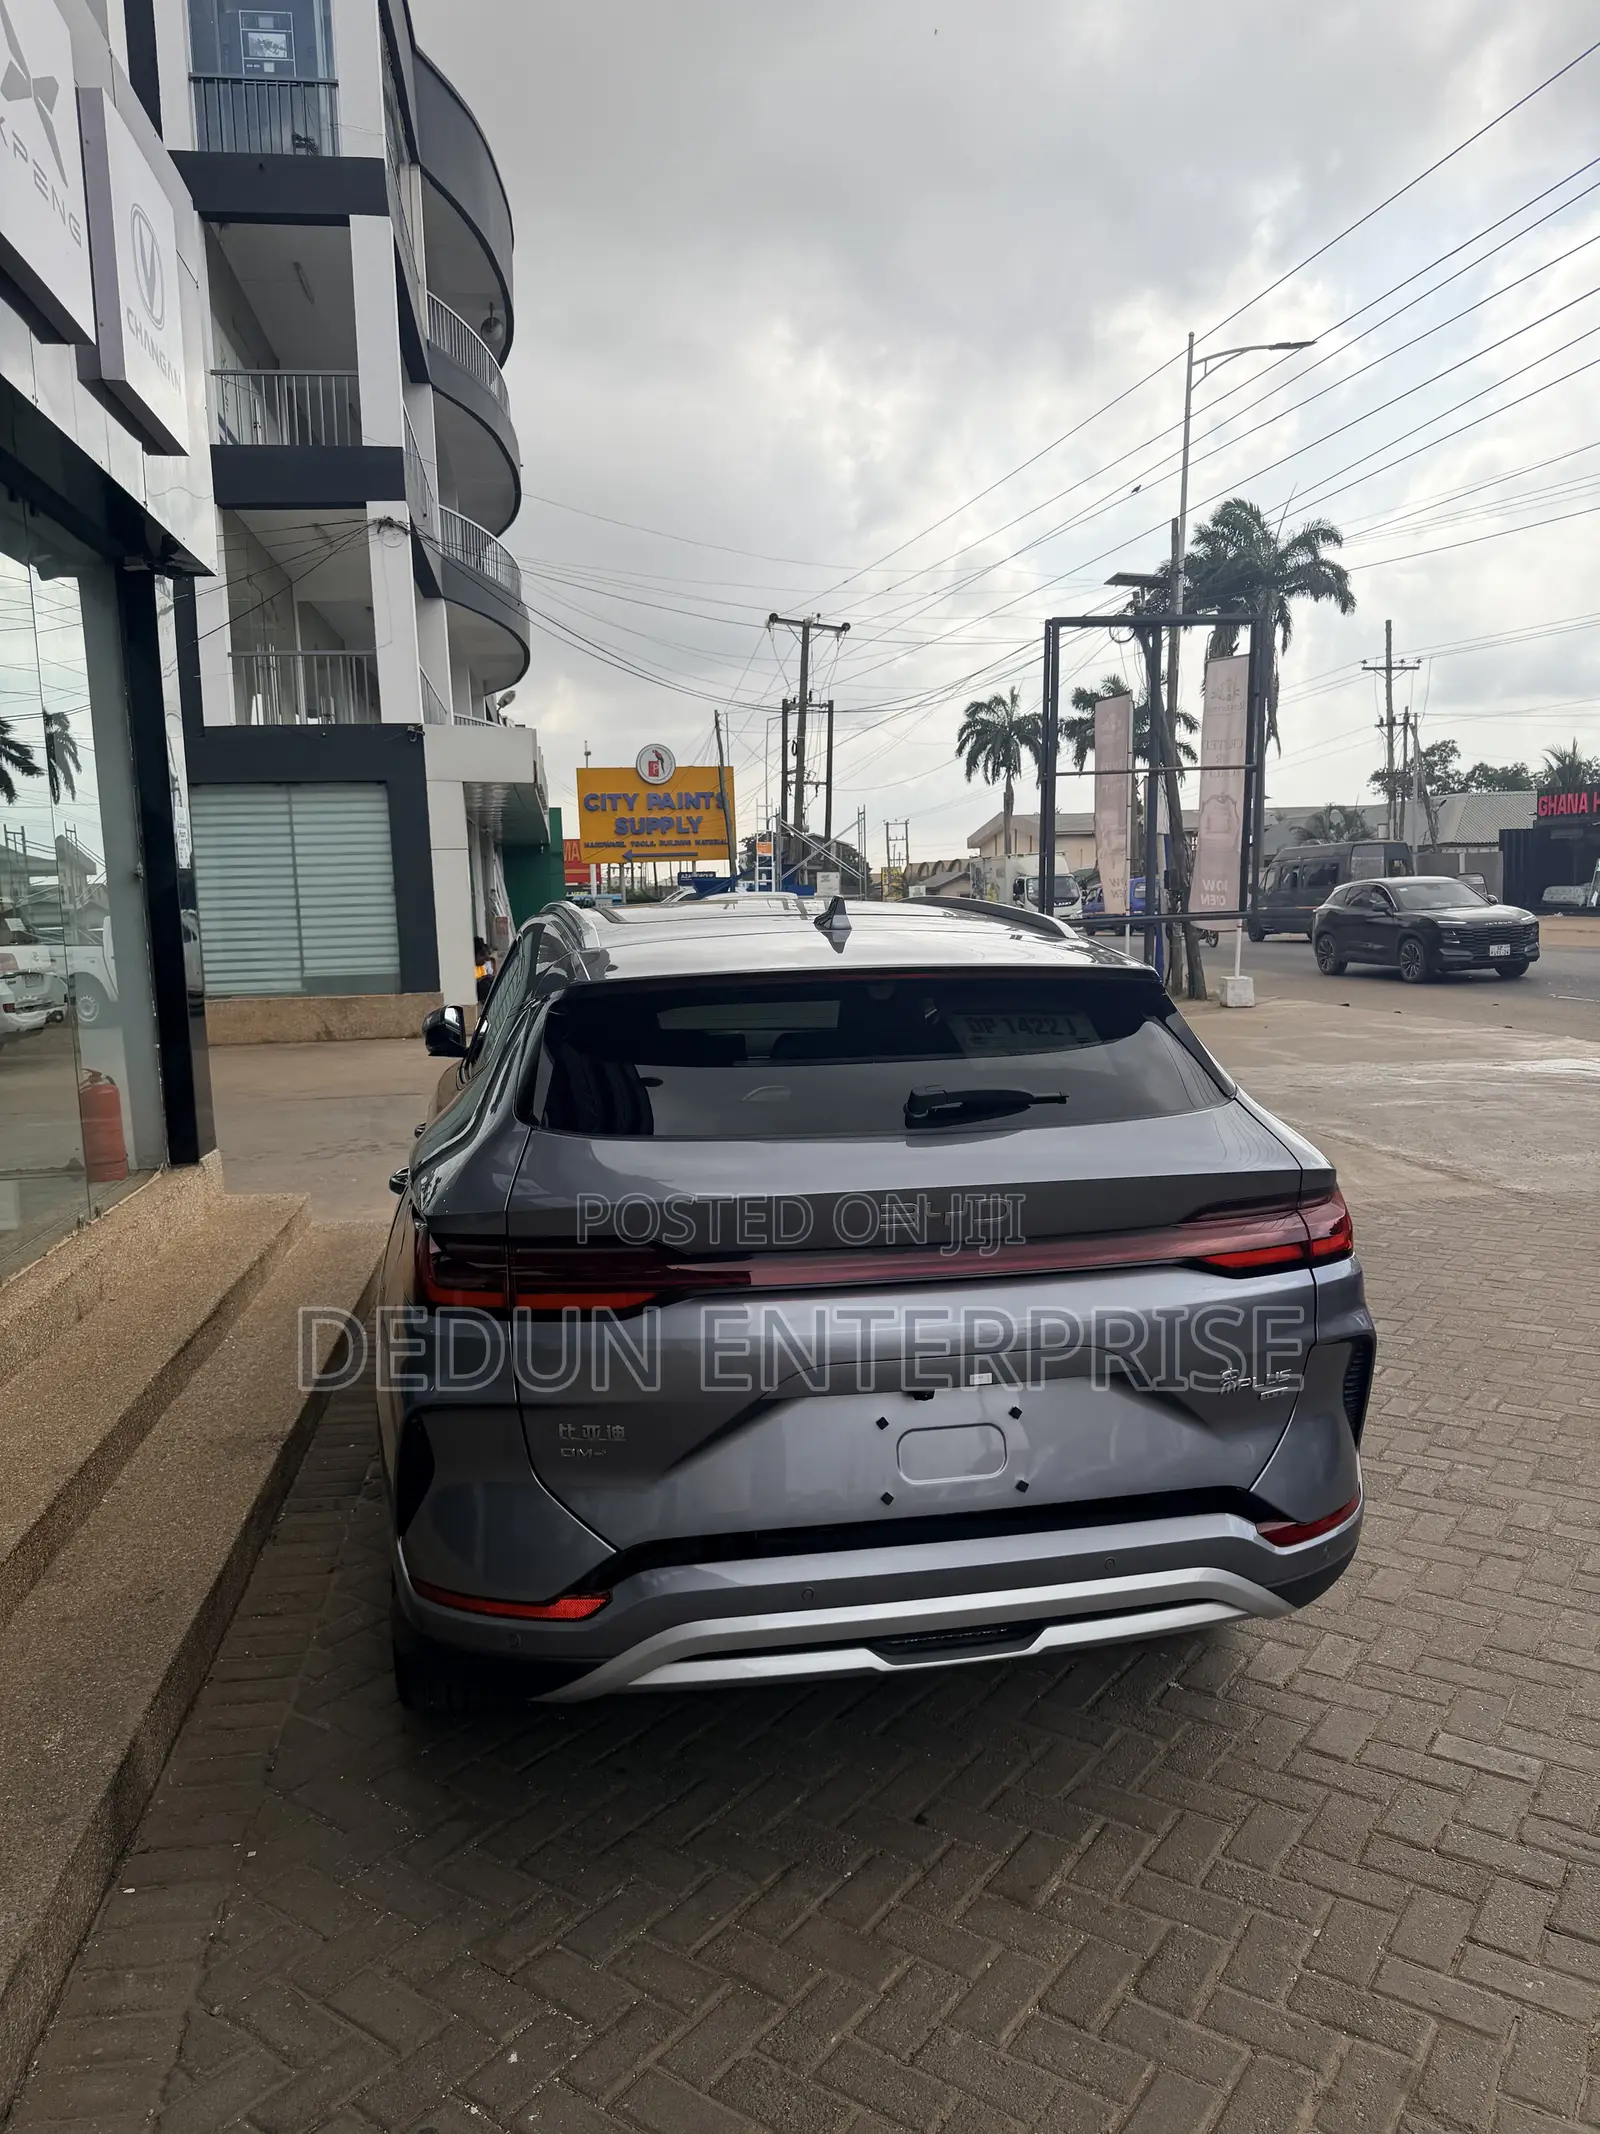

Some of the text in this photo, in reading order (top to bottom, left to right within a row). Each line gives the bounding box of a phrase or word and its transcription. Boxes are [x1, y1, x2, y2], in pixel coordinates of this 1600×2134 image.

[126, 305, 182, 396] CHANGAN
[584, 792, 640, 812] CITY
[1538, 791, 1588, 817] GHANA
[614, 815, 704, 835] SUPPLY
